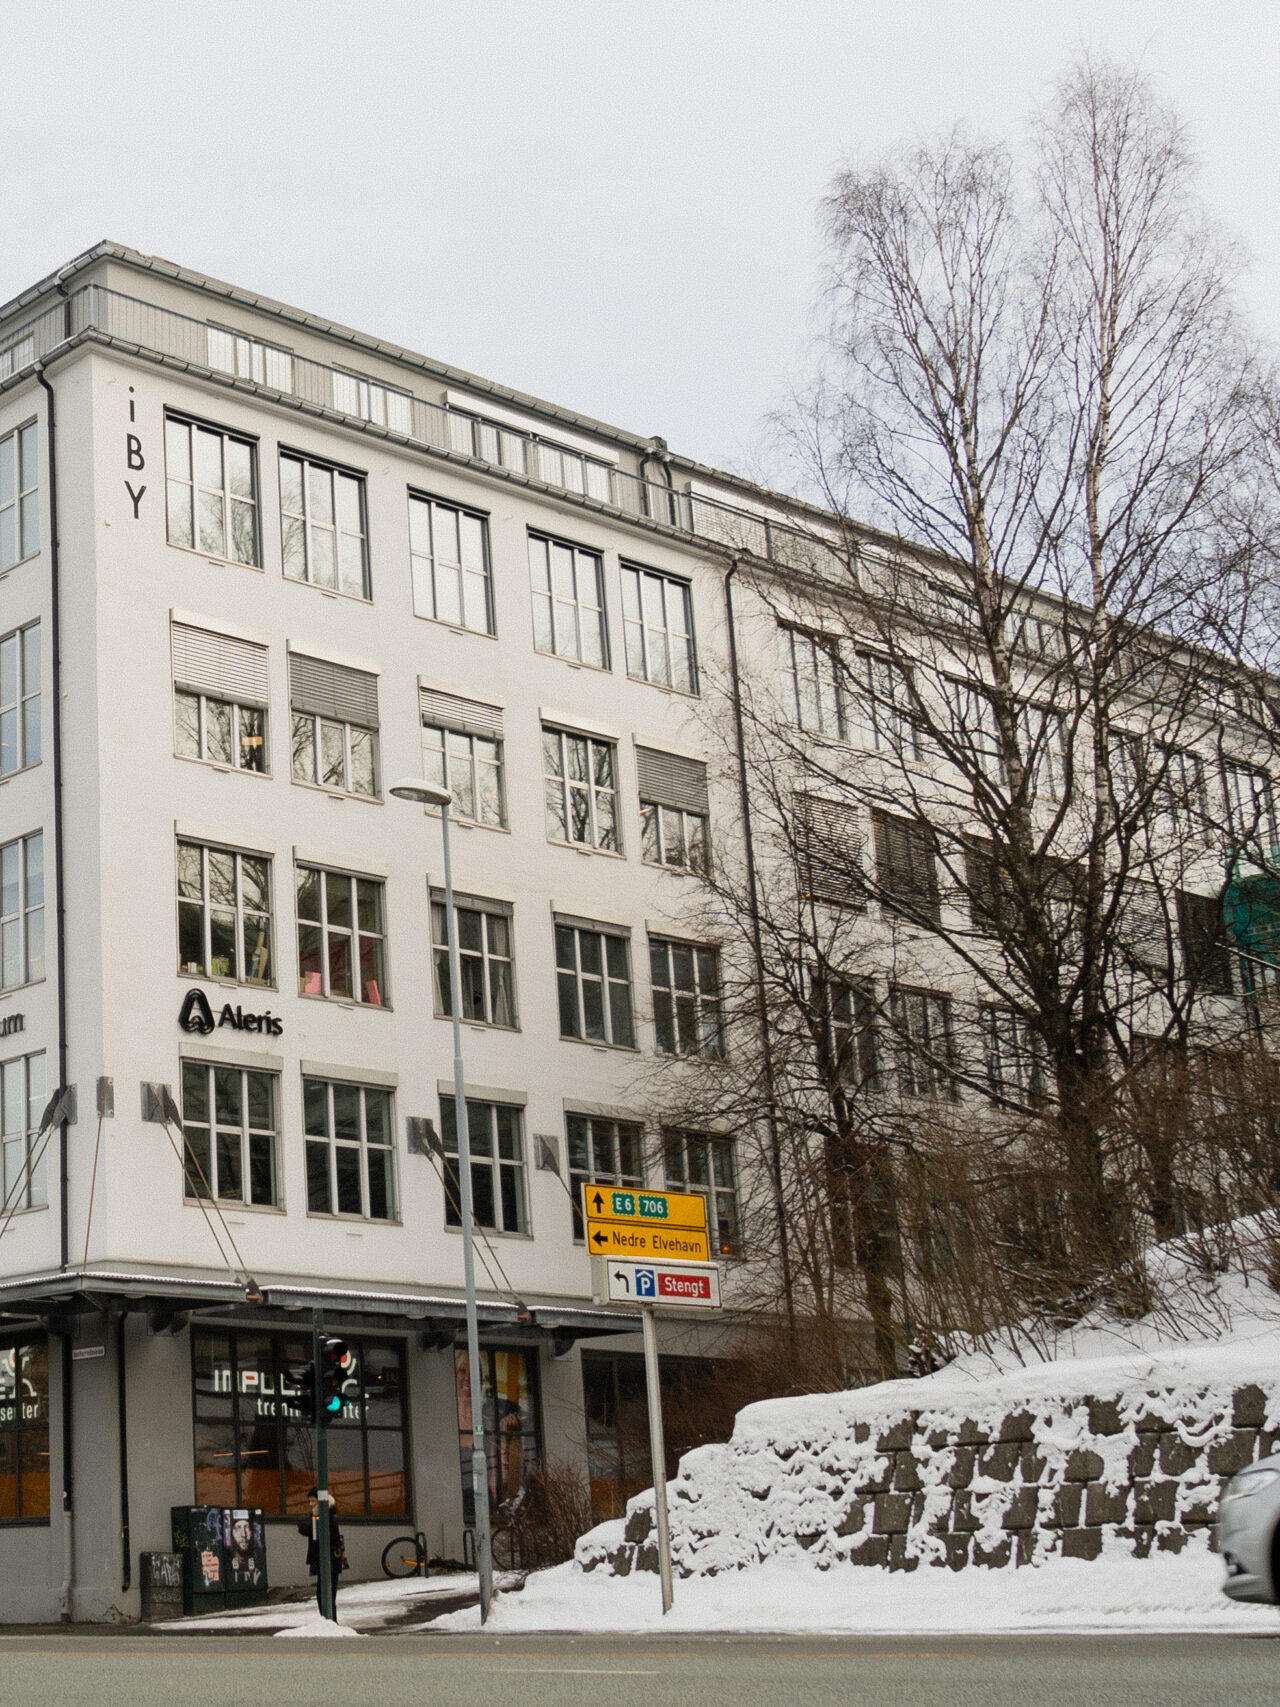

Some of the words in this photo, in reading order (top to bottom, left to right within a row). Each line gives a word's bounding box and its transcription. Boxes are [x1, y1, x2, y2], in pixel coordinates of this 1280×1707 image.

[218, 1003, 284, 1035] Aleris
[642, 1200, 664, 1214] 706
[612, 1231, 646, 1248] Nedre
[652, 1235, 702, 1253] Elvehavn
[640, 1277, 651, 1295] P
[664, 1277, 704, 1297] Stengt
